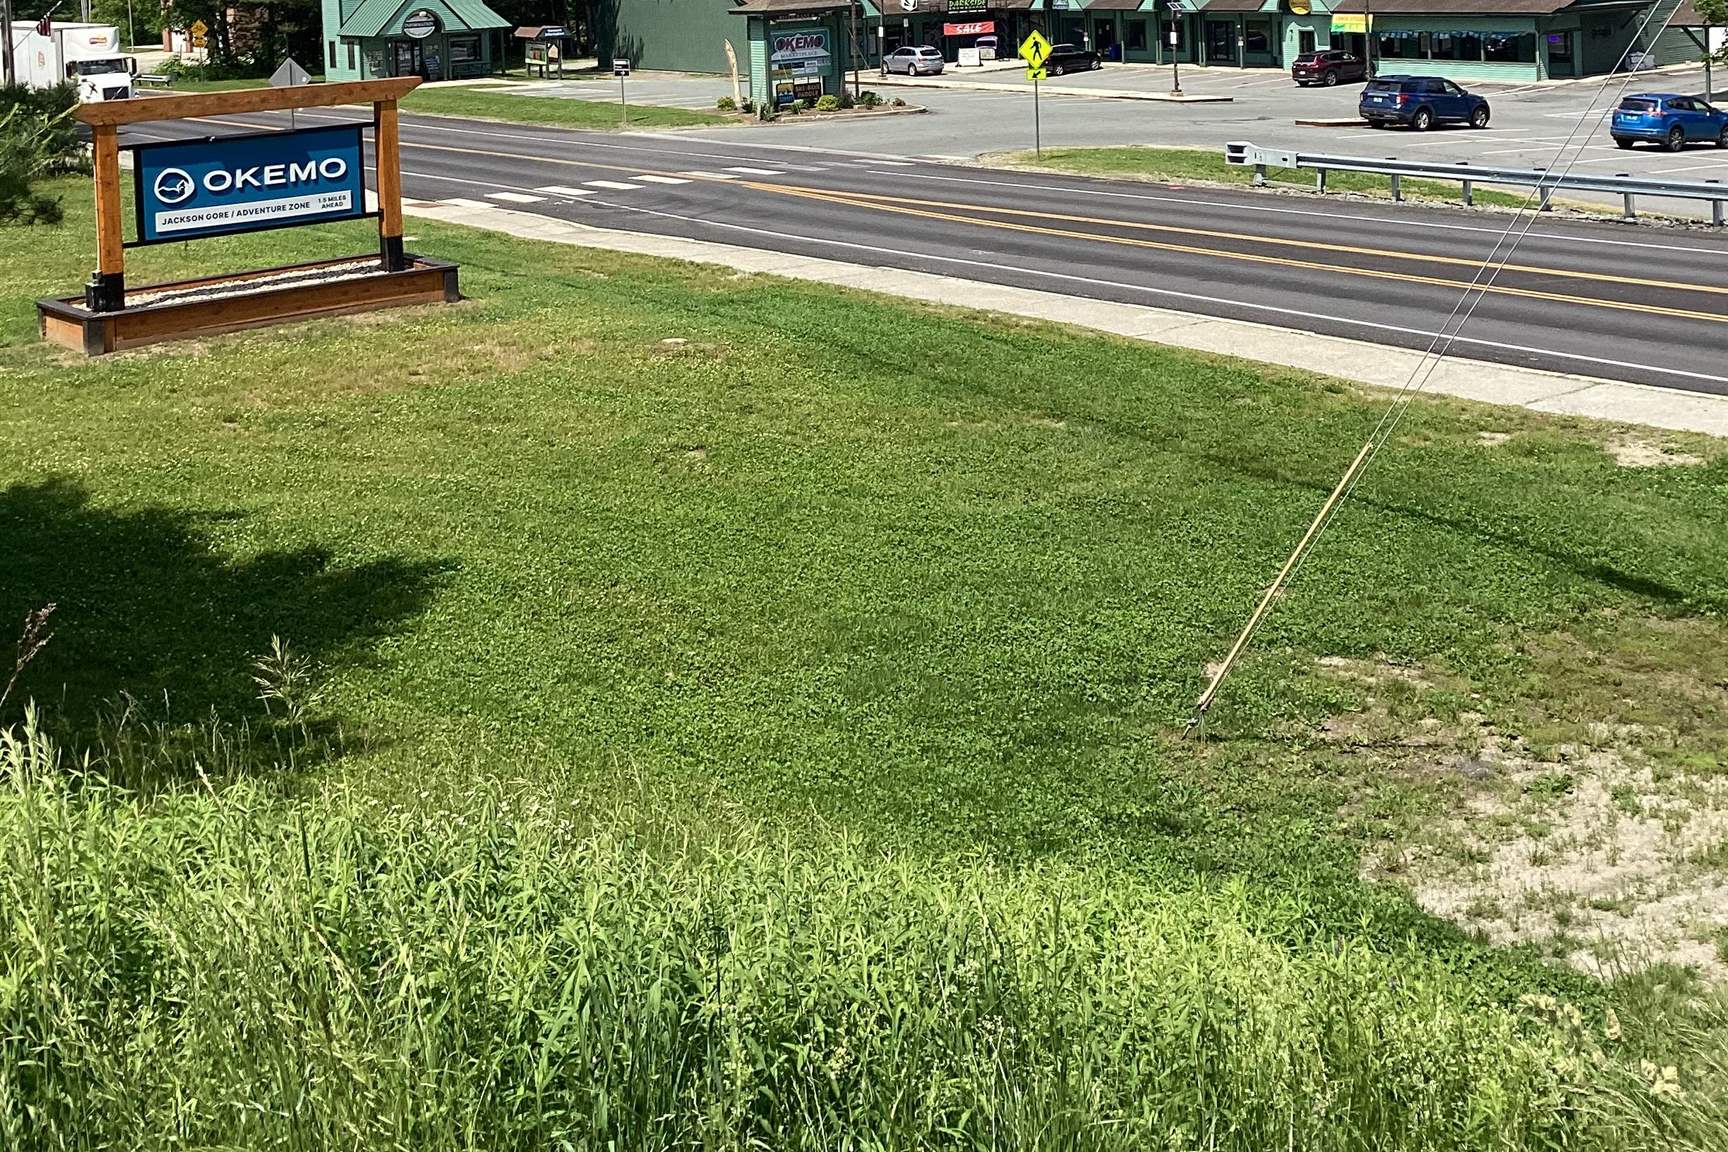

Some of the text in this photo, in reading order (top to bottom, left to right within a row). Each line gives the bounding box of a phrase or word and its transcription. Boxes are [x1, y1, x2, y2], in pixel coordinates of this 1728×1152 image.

[957, 22, 982, 34] SALE
[775, 35, 825, 51] OKEMO
[203, 157, 347, 191] OKEMO
[162, 214, 204, 225] JACKSON
[206, 211, 229, 220] GORE
[236, 204, 287, 217] ADVENTURE
[288, 201, 310, 211] ZONE
[321, 201, 344, 209] AHEAD
